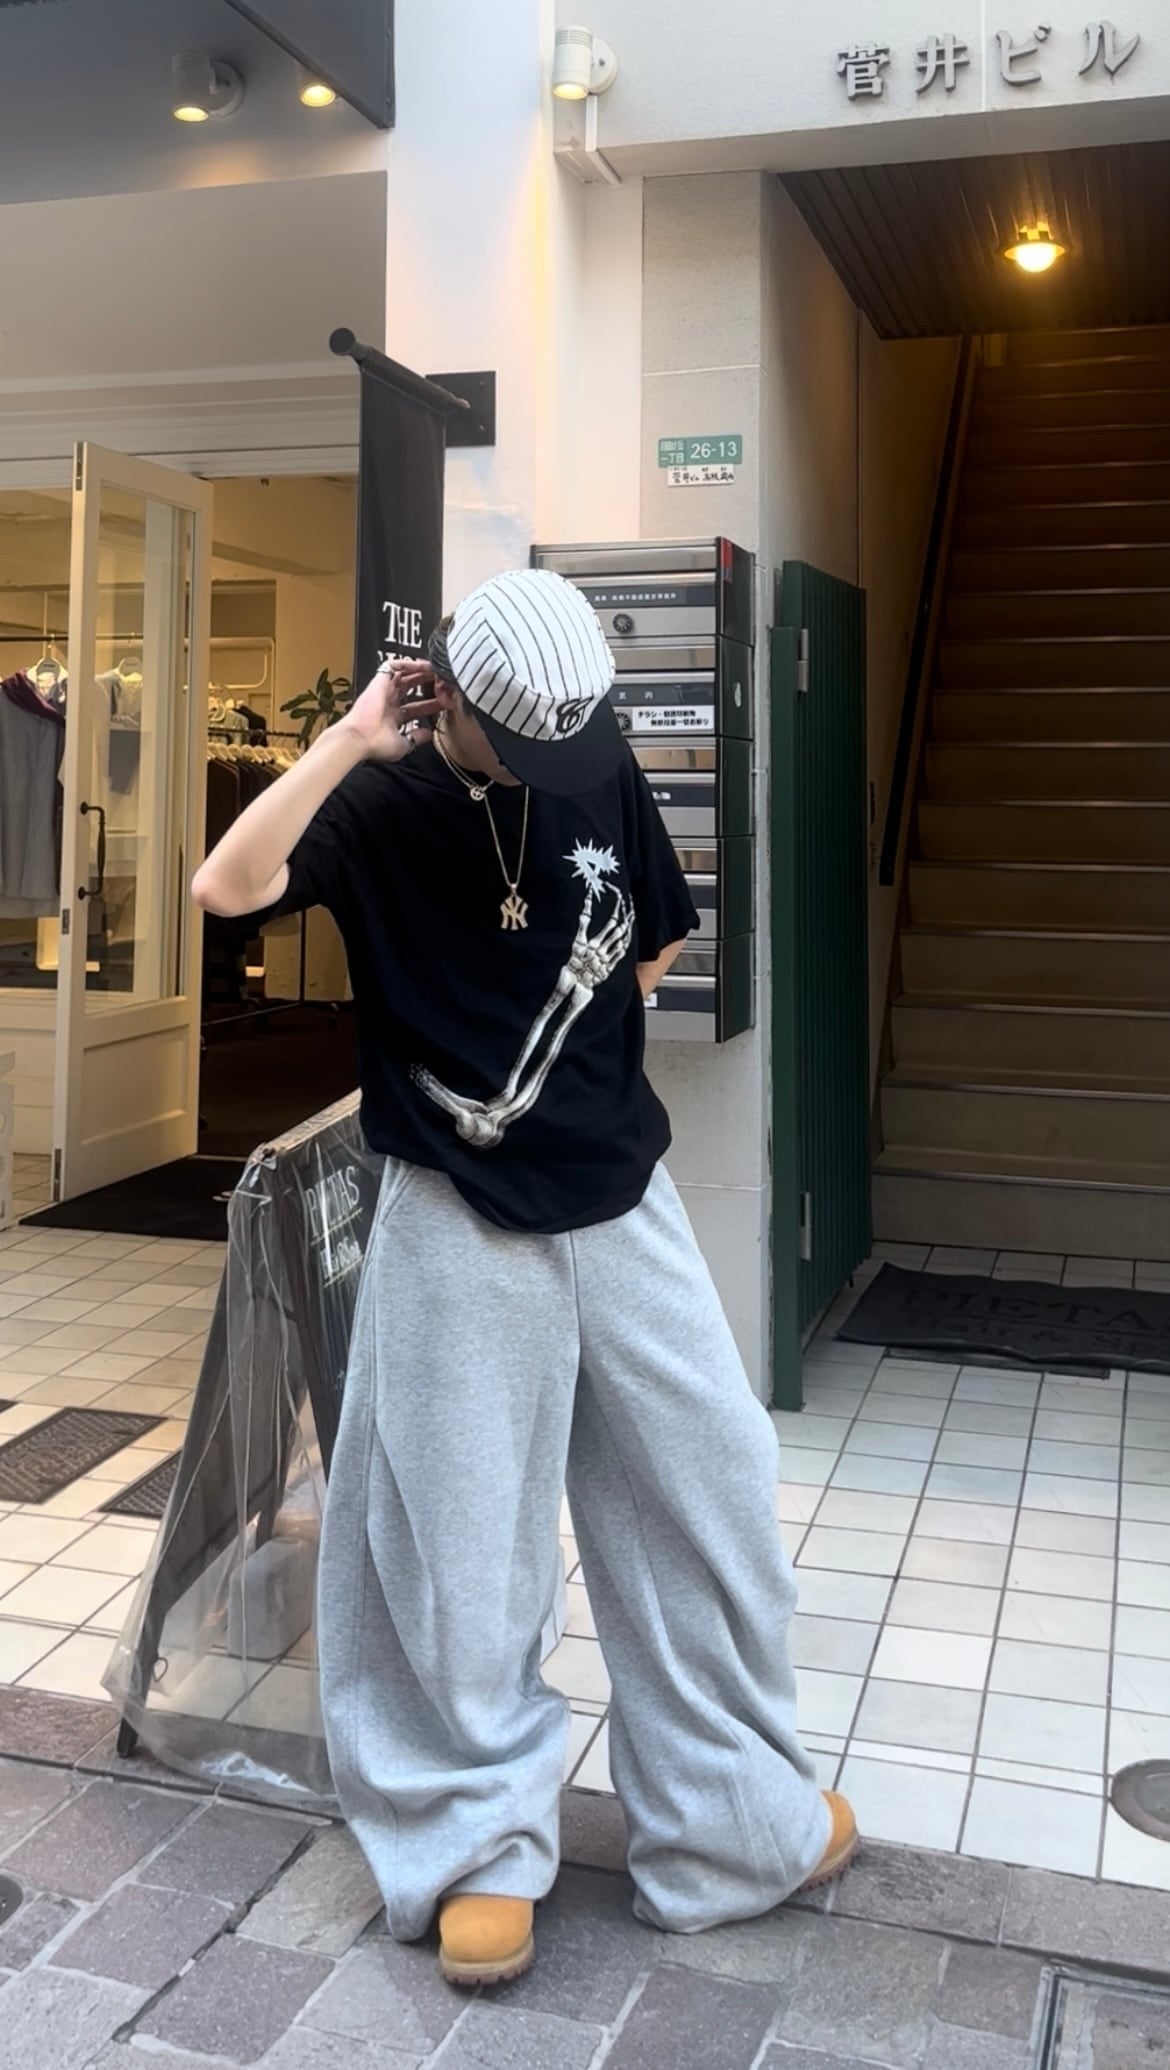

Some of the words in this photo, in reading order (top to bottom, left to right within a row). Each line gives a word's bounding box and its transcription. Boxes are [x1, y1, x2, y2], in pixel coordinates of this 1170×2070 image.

[837, 20, 1141, 101] 菅井ビル
[690, 441, 737, 459] 26-13
[382, 601, 423, 649] THE
[500, 895, 528, 930] NY
